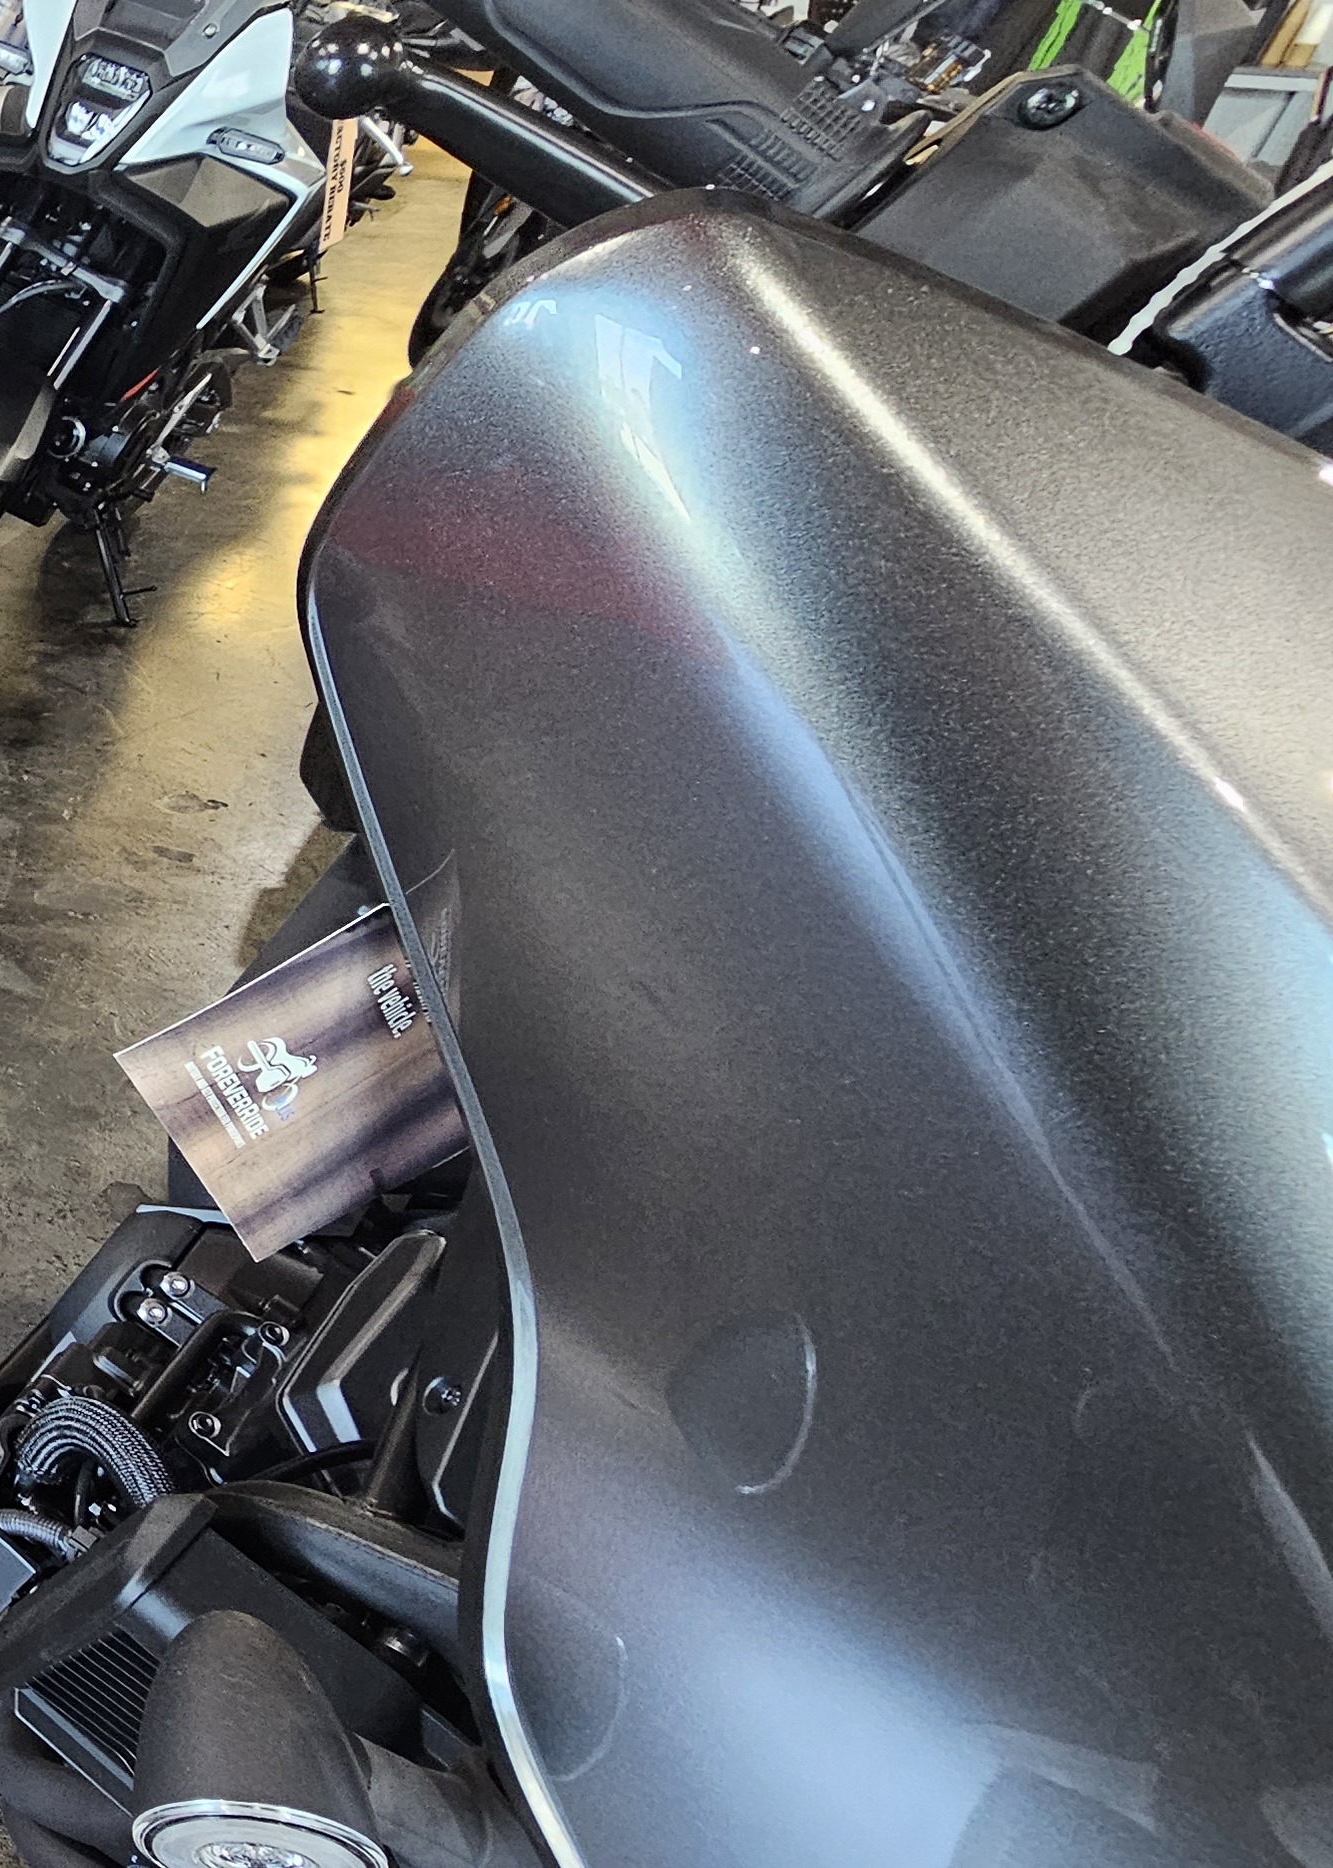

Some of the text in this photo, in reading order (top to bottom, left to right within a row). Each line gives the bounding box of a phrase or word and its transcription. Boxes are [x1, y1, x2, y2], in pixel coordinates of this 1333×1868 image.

[323, 186, 336, 242] REBATE
[367, 963, 417, 1039] the vehicle.
